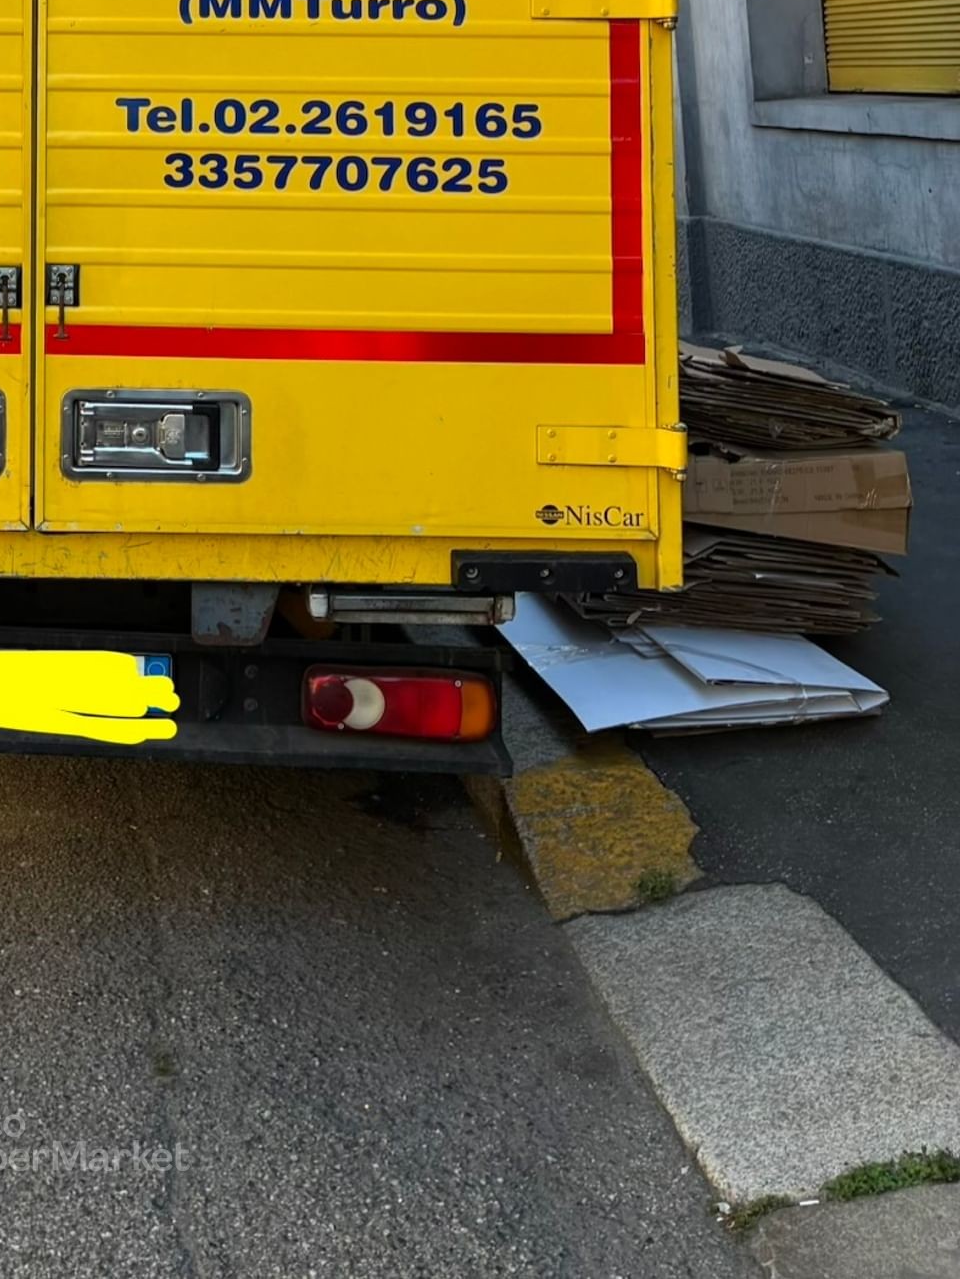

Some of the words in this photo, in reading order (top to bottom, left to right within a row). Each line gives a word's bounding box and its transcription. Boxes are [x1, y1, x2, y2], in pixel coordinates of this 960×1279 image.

[116, 98, 543, 138] Tel.02.2619165
[163, 153, 509, 194] 3357707625
[565, 504, 645, 527] NisCar
